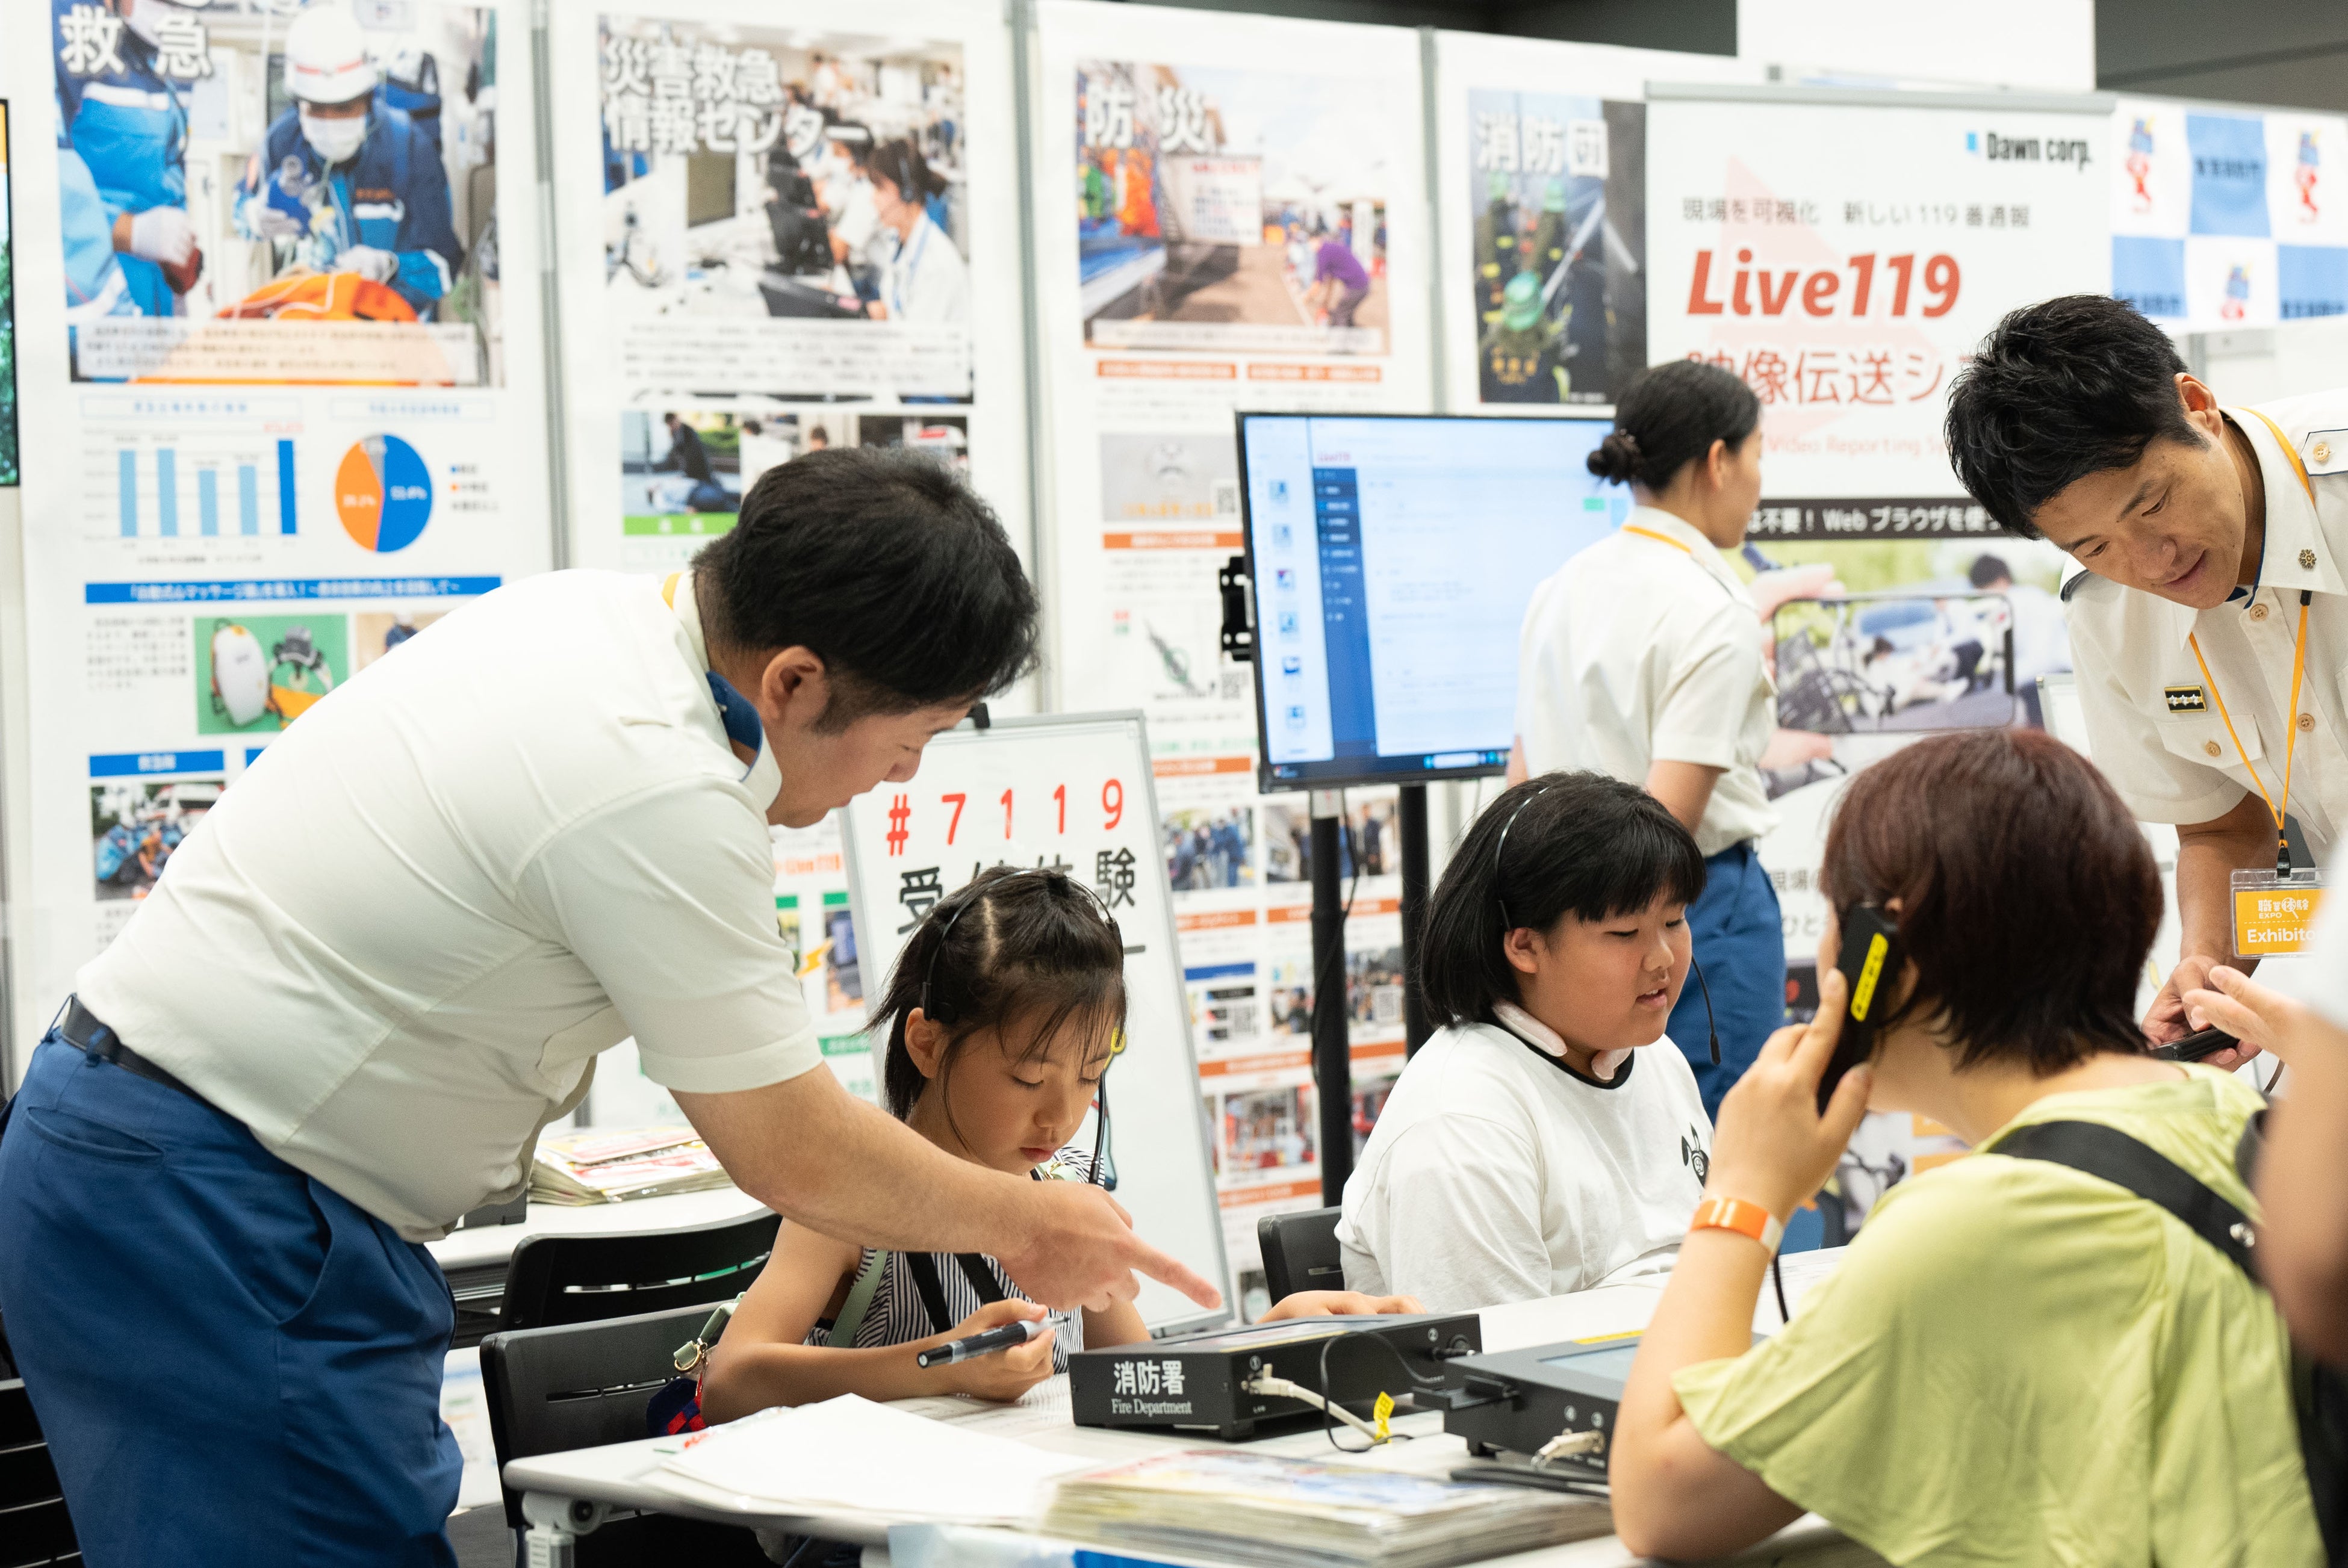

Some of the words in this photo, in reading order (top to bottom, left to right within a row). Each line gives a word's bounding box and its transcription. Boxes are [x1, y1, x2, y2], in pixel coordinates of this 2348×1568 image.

[60, 8, 211, 76] 救急
[604, 37, 781, 105] 災害救急
[607, 98, 868, 156] 情報センター
[1085, 84, 1213, 152] 防災
[1476, 117, 1608, 178] 消防団
[1987, 132, 2040, 160] Dawn
[2047, 134, 2091, 170] corp.
[1683, 198, 1819, 224] 現場を可視化
[1843, 202, 2030, 228] 新しい119番通報
[1685, 249, 1961, 317] Live119
[1688, 347, 1981, 405] 像伝送シ
[1822, 508, 1868, 532] Web
[897, 846, 1136, 934] 受験
[1114, 1360, 1185, 1395] 消防署
[1111, 1398, 1131, 1414] Fire
[1134, 1398, 1192, 1418] Department
